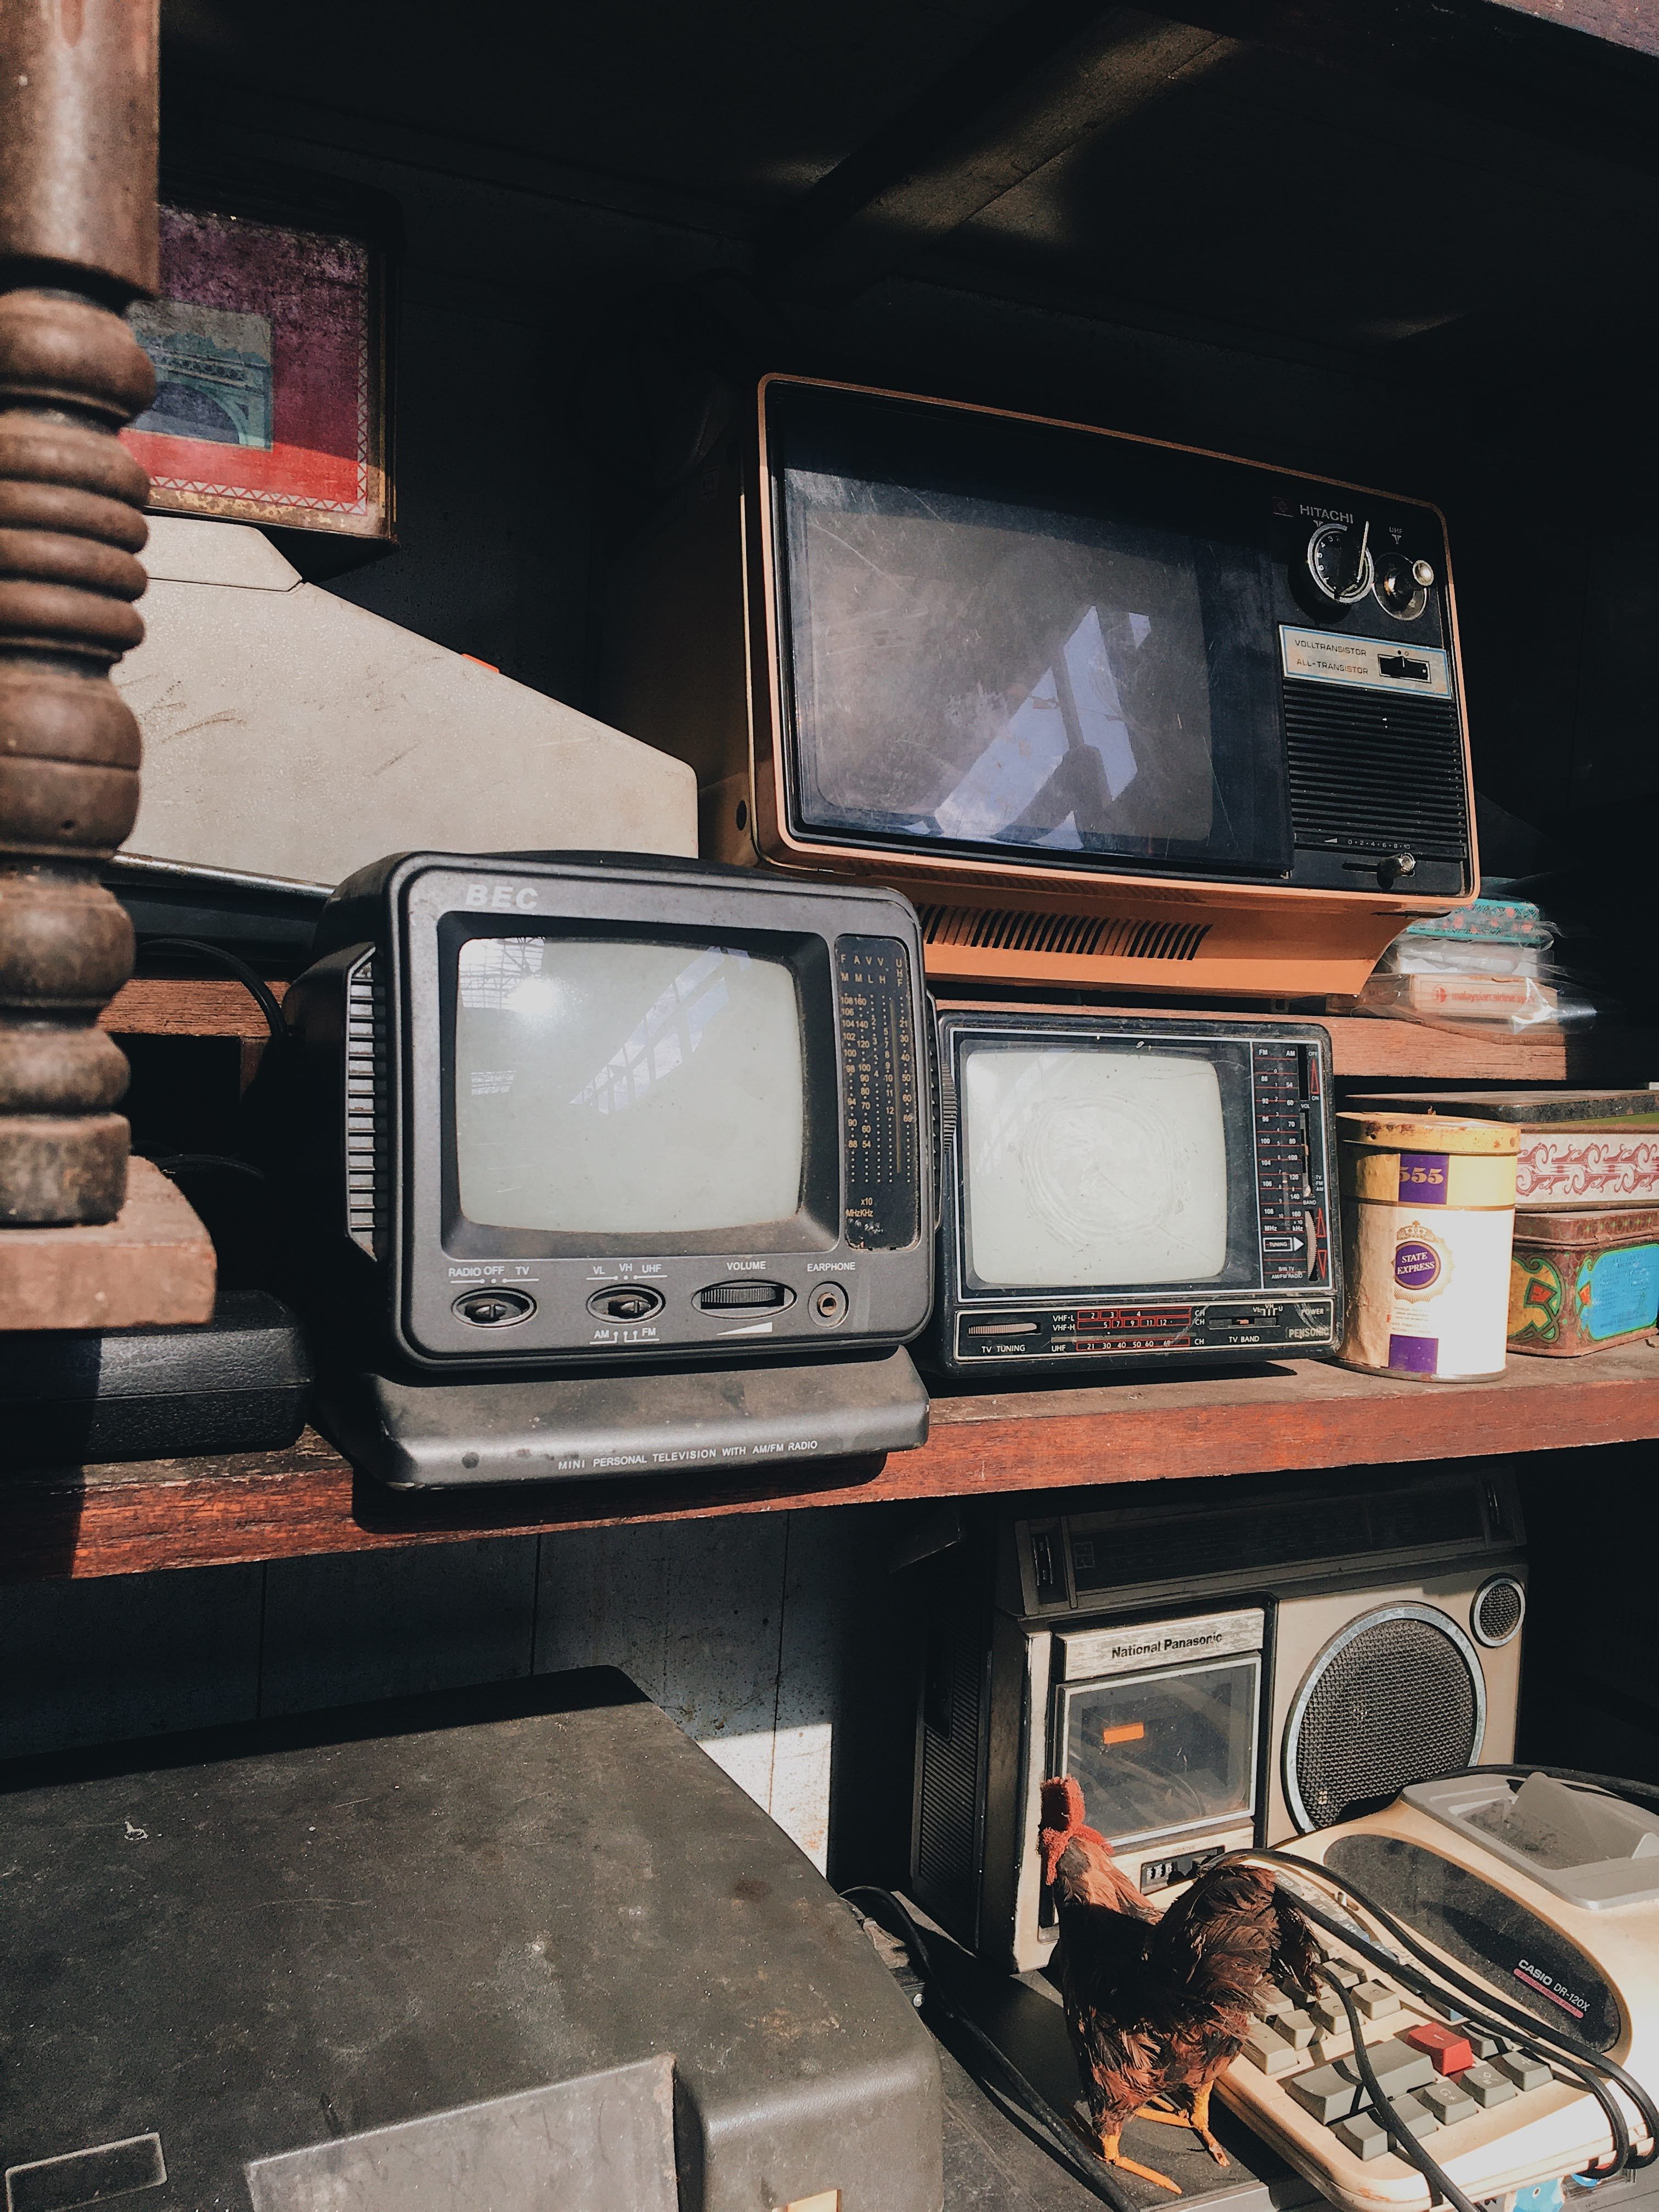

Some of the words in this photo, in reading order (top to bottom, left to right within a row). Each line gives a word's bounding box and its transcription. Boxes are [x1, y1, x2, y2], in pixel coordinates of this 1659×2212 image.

[1300, 504, 1353, 524] HITACHI
[1294, 639, 1367, 657] VOLLTRANSISTOR
[1296, 658, 1369, 675] ALL-TRANSISTOR
[466, 884, 538, 910] BEC
[843, 1032, 856, 1041] 102
[857, 1040, 870, 1048] 120
[844, 1049, 857, 1057] 100
[859, 1064, 871, 1072] 100
[886, 1107, 894, 1115] 12
[1400, 1166, 1444, 1184] 555
[861, 1197, 873, 1206] x10
[846, 1209, 860, 1217] MHz
[860, 1209, 873, 1217] KHz
[1401, 1251, 1428, 1263] STATE
[448, 1267, 482, 1277] RADIO
[483, 1266, 505, 1276] OFF
[515, 1266, 530, 1276] TV
[592, 1266, 605, 1274] VL
[619, 1263, 633, 1272] VH
[642, 1263, 662, 1273] UHF
[726, 1261, 766, 1271] VOLUME
[807, 1262, 856, 1272] EARPHONE
[1397, 1261, 1435, 1275] EXPRESS
[594, 1329, 610, 1339] AM
[642, 1327, 656, 1336] FM
[1289, 1326, 1330, 1339] PENSONIC
[1240, 1335, 1260, 1343] BAND
[996, 1345, 1025, 1353] TUNING
[558, 1460, 585, 1470] MINI
[592, 1455, 648, 1468] PERSONAL
[652, 1448, 716, 1463] TELEVISION
[721, 1446, 746, 1457] WITH
[752, 1443, 784, 1455] AM/FM
[788, 1440, 819, 1451] RADIO
[1111, 1641, 1161, 1658] National
[1164, 1632, 1222, 1651] Panasonic
[1172, 1845, 1195, 1855] COUNTER
[1518, 1959, 1553, 1986] CASIO
[1553, 1982, 1590, 2012] DR-120X
[1525, 1976, 1542, 1989] COLOR
